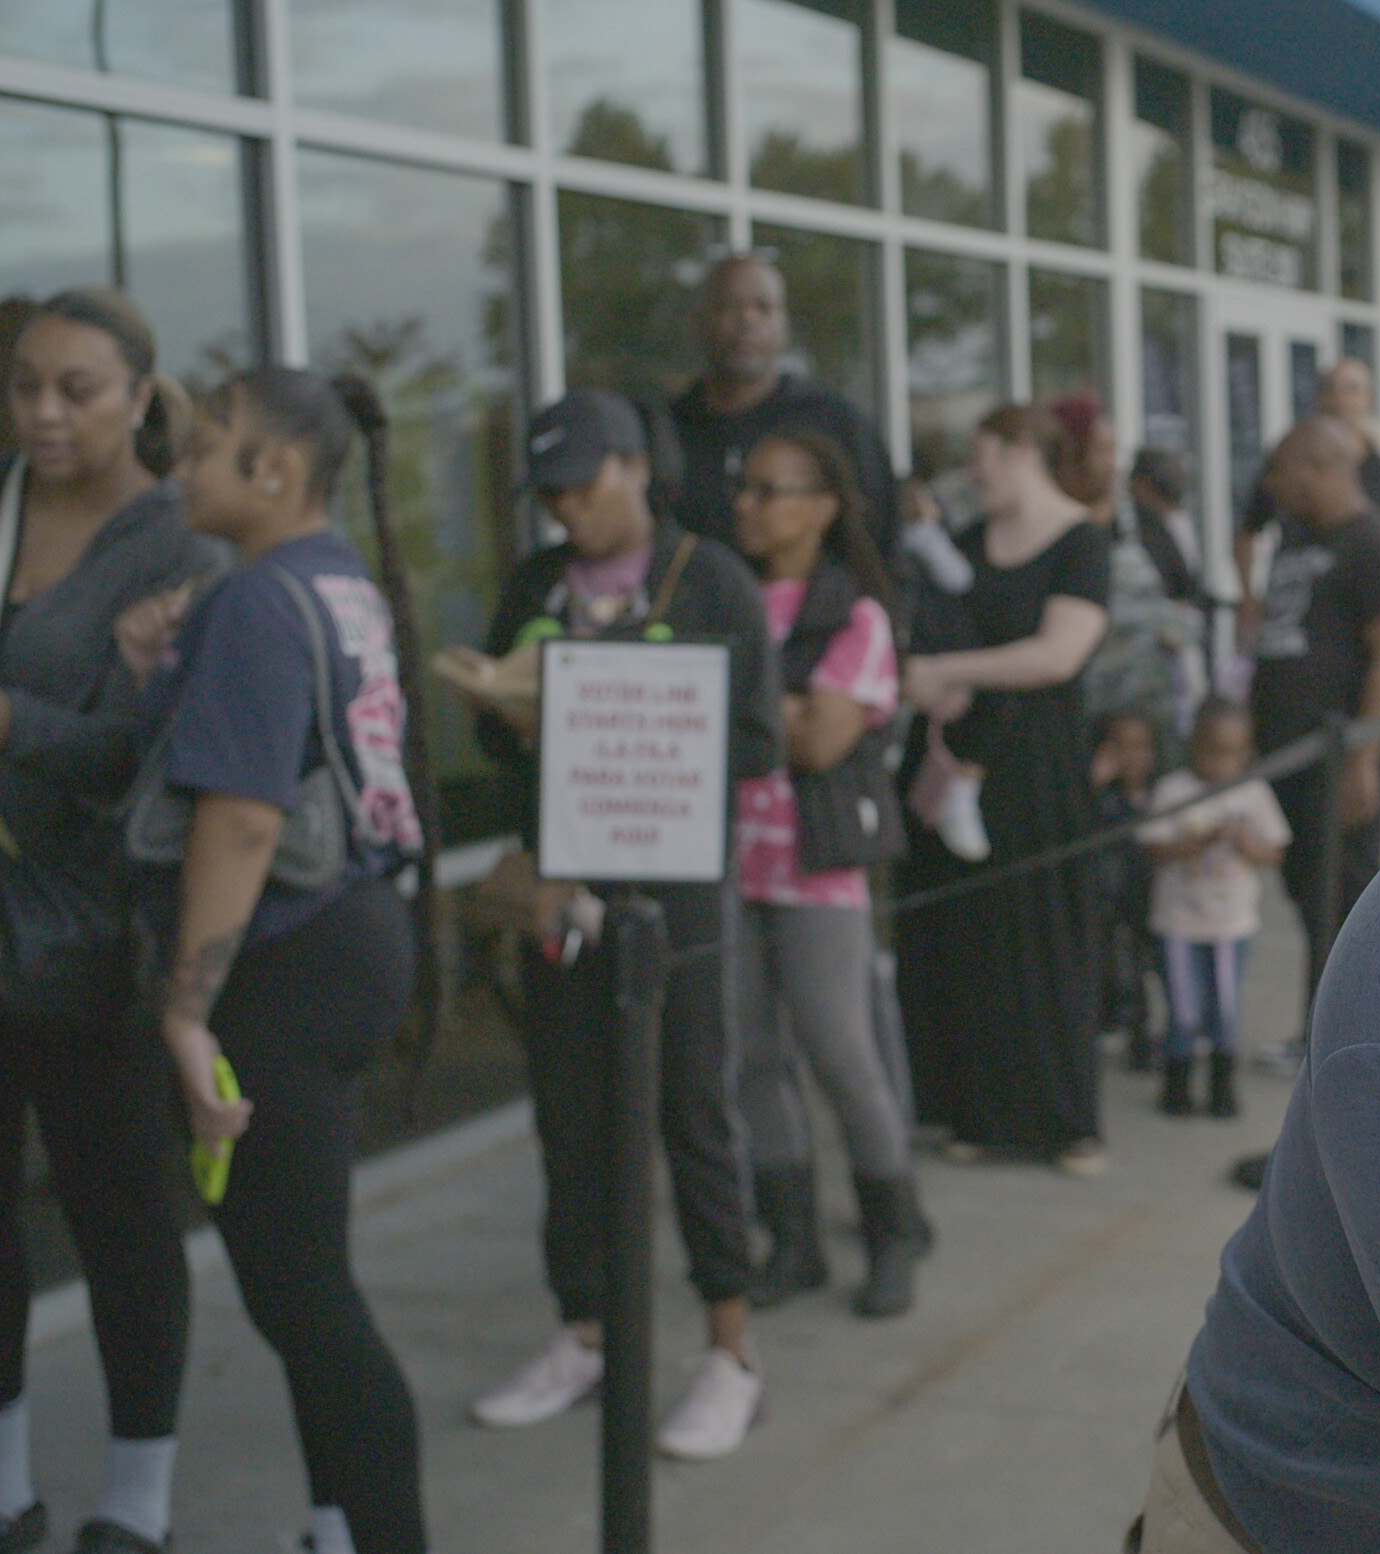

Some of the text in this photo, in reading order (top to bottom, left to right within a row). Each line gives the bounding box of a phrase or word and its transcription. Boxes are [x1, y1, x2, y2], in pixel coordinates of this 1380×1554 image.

[578, 683, 644, 702] VOTER
[567, 711, 648, 732] STARTS
[570, 768, 700, 789] PARA VOTAR
